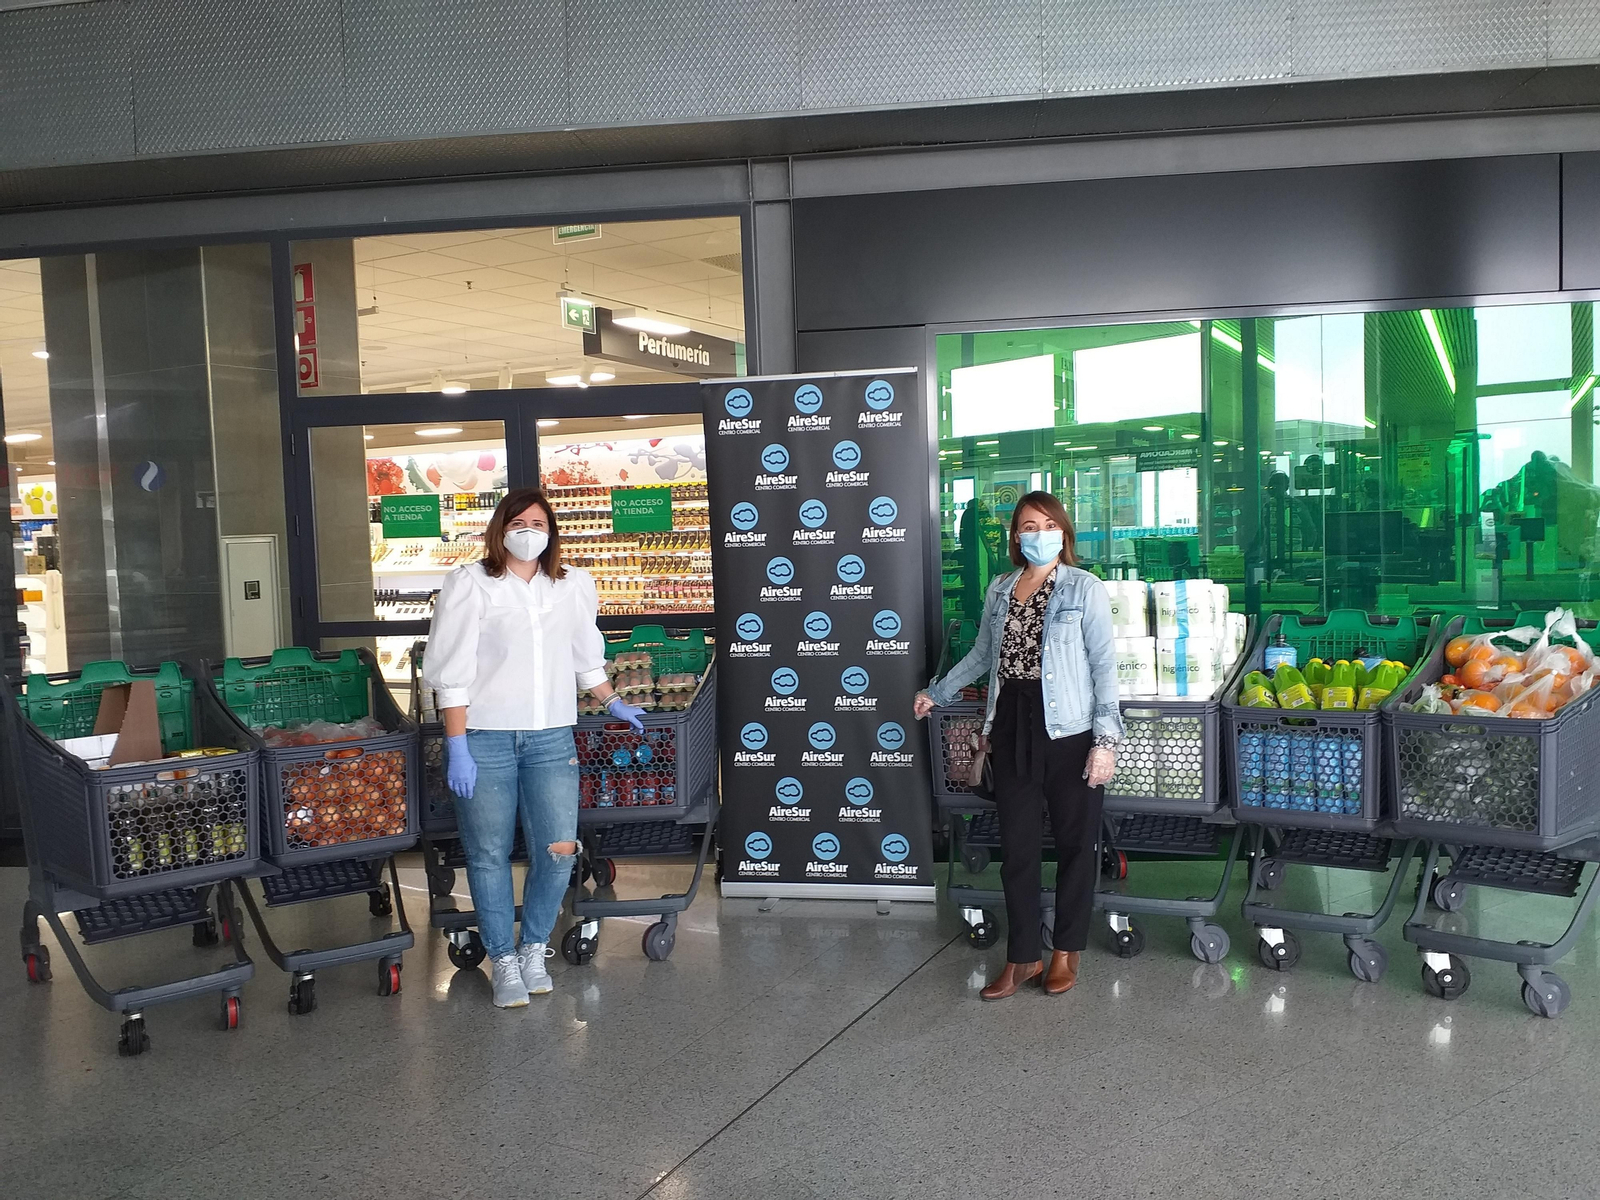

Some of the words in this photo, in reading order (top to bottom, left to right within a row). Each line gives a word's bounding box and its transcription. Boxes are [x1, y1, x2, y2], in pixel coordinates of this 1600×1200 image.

[558, 225, 594, 234] EMERGENCIA
[638, 331, 710, 366] Perfumería
[788, 415, 831, 427] AireSur
[858, 411, 903, 423] AireSur
[718, 418, 761, 430] AireSur
[755, 474, 798, 485] AireSur
[826, 471, 870, 482] AireSur
[724, 531, 767, 542] AireSur
[792, 529, 836, 540] AireSur
[862, 527, 906, 538] AireSur
[760, 586, 802, 596] AireSur
[830, 584, 873, 595] AireSur
[730, 642, 772, 652] AireSur
[797, 640, 840, 651] AireSur
[866, 639, 910, 650] AireSur
[1163, 664, 1200, 674] higiénico
[764, 696, 807, 706] AireSur
[834, 695, 878, 706] AireSur
[734, 751, 776, 761] AireSur
[801, 751, 844, 761] AireSur
[870, 751, 914, 761] AireSur
[769, 806, 811, 816] AireSur
[838, 807, 882, 817] AireSur
[738, 860, 780, 871] AireSur
[806, 862, 848, 872] AireSur
[874, 863, 918, 874] AireSur
